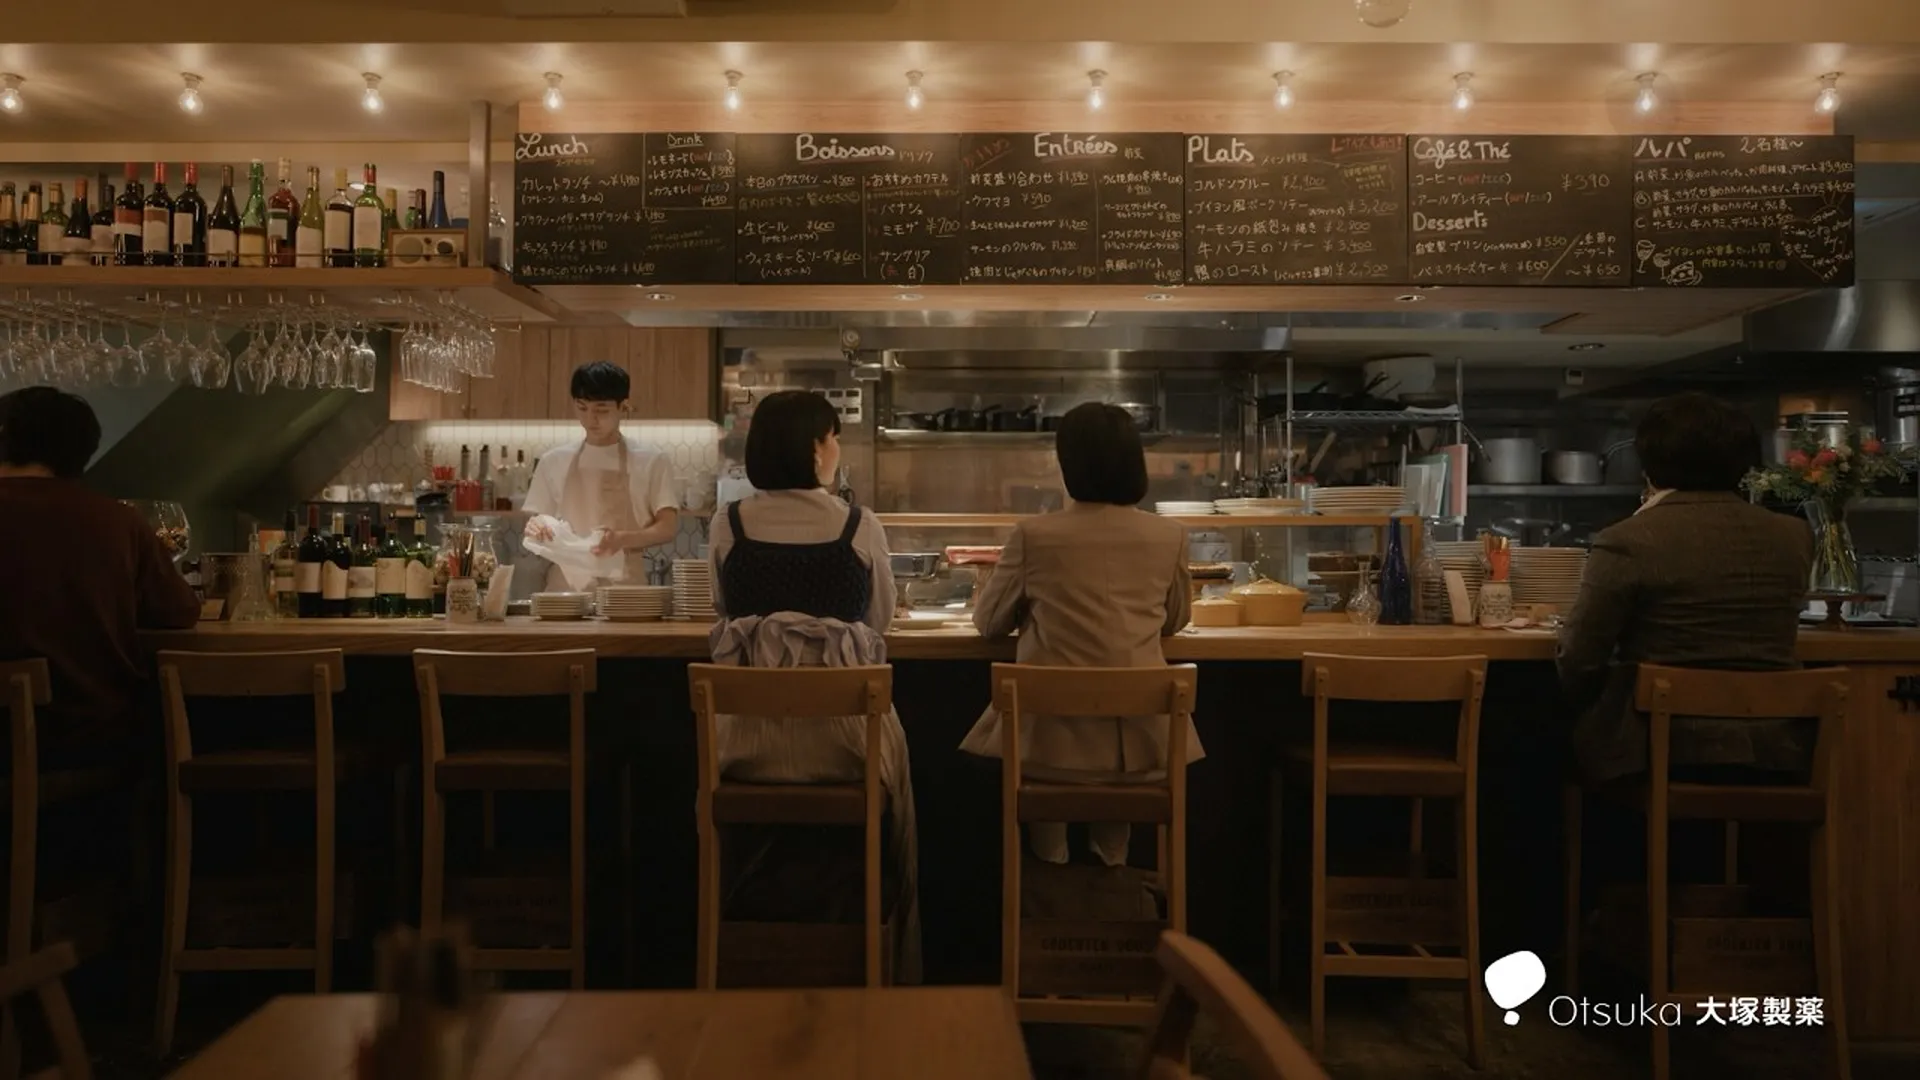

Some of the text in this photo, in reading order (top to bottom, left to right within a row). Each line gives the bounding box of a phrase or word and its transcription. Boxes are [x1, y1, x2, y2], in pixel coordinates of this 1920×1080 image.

[516, 133, 589, 160] Lunch
[666, 134, 703, 146] Drink
[796, 133, 895, 162] Boissons
[1034, 133, 1118, 157] Entrées
[1634, 137, 1691, 158] ルパ
[1188, 136, 1255, 163] Plats
[899, 151, 933, 164] ドリンク
[872, 173, 949, 187] おすすめカクテル
[1194, 178, 1270, 190] コルドンブルー
[1561, 173, 1610, 191] ¥390
[1347, 199, 1398, 214] ¥3,200
[744, 221, 789, 236] 生ビール
[882, 218, 960, 236] ミモザ ¥700
[1413, 210, 1488, 232] Desserts
[1198, 241, 1315, 259] 牛ハラミのソテー
[1323, 240, 1372, 253] ¥3,400
[1415, 240, 1483, 255] 自家製プリン
[1573, 246, 1615, 257] デザート
[880, 249, 931, 263] サングリア
[760, 266, 812, 279] (ハイボール)
[1194, 263, 1268, 280] 鴨のロースト
[1419, 262, 1549, 276] バスクチーズケーキ ¥600
